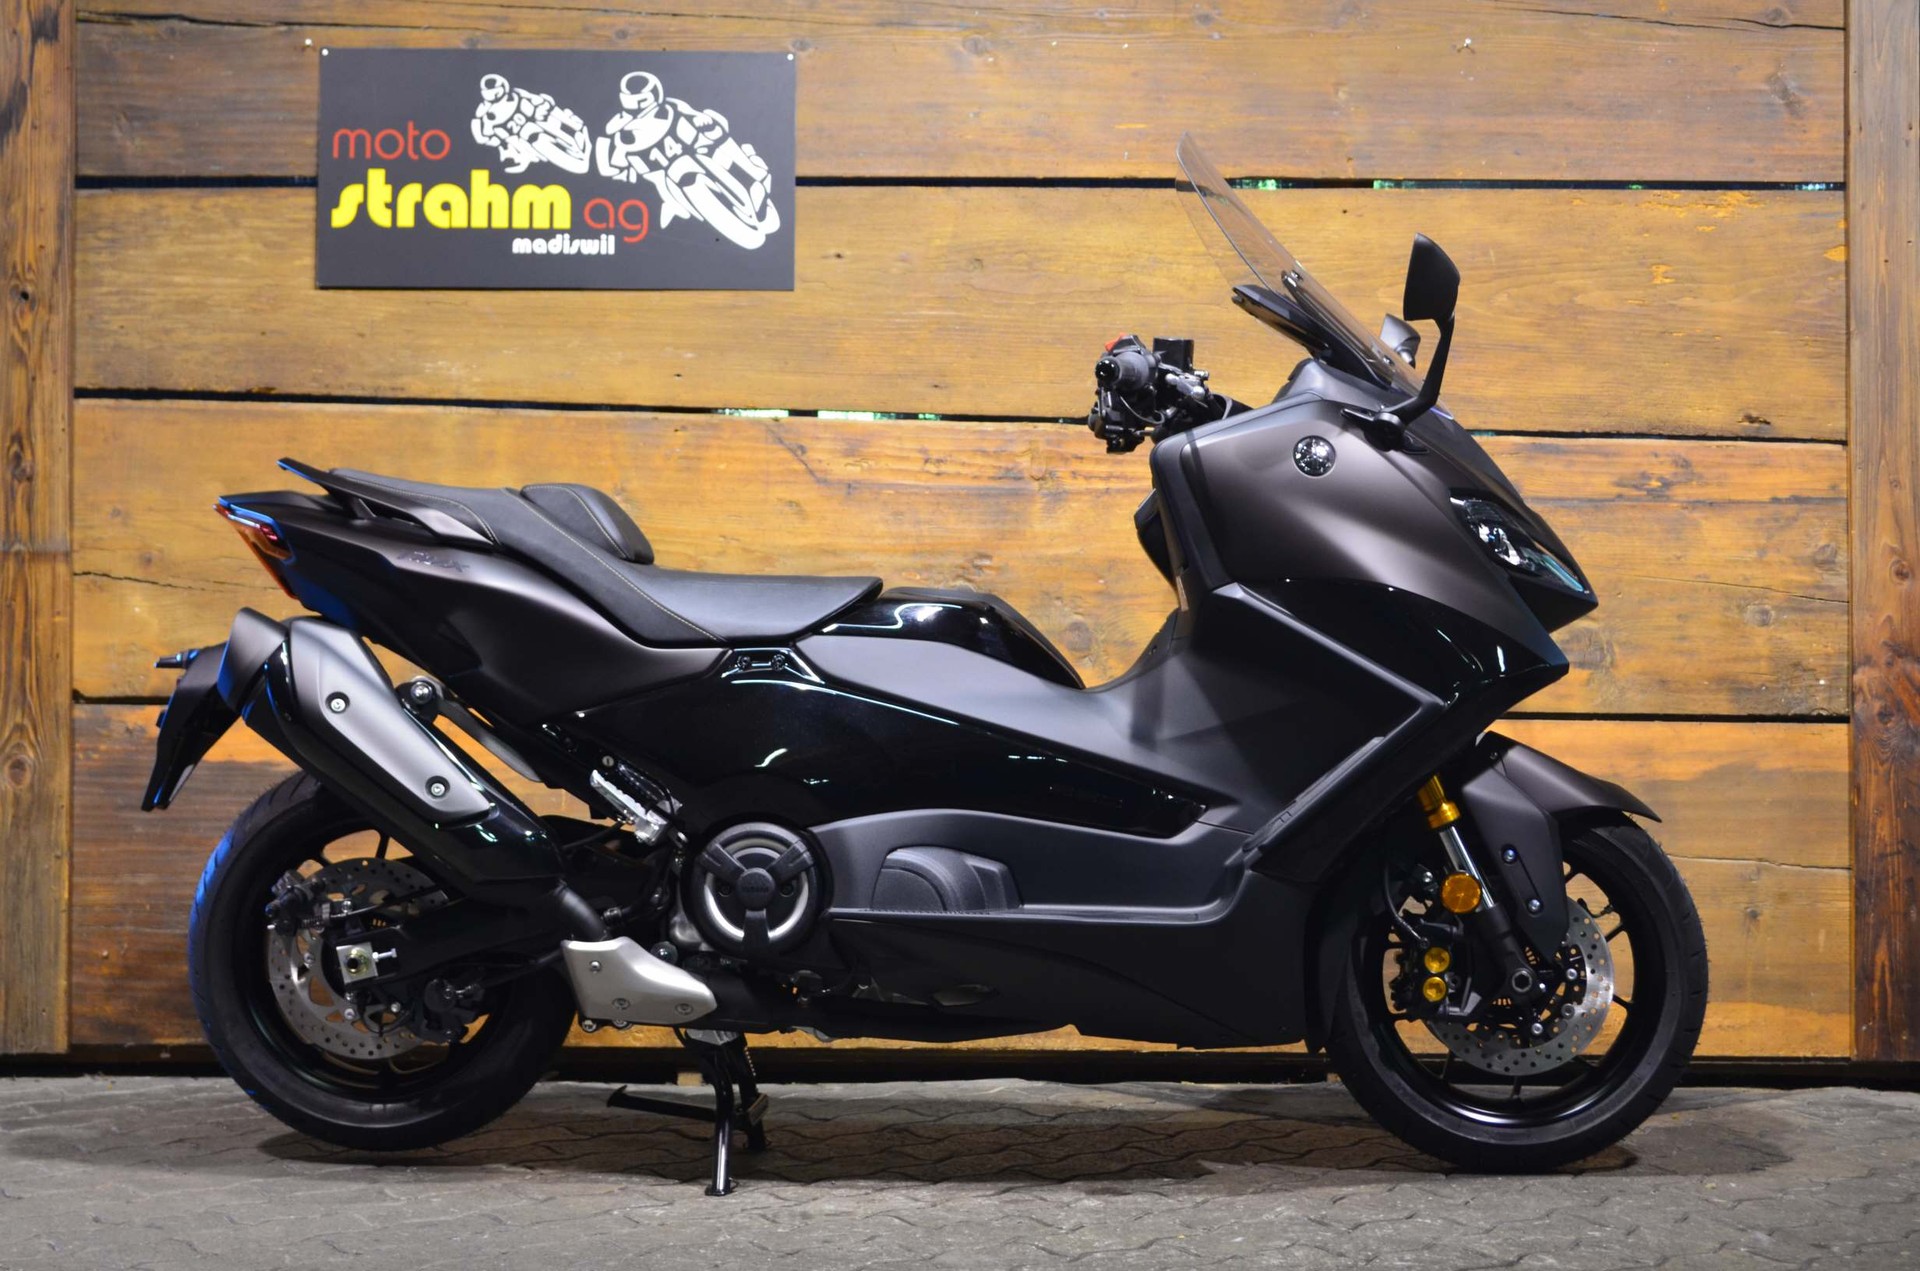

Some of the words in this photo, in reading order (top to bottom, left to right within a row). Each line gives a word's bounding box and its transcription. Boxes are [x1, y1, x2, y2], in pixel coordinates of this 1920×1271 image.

[507, 113, 526, 134] 20
[332, 121, 451, 160] moto
[650, 136, 683, 167] 14
[330, 168, 571, 229] strahm
[583, 198, 649, 243] ag
[512, 233, 615, 255] madiswil
